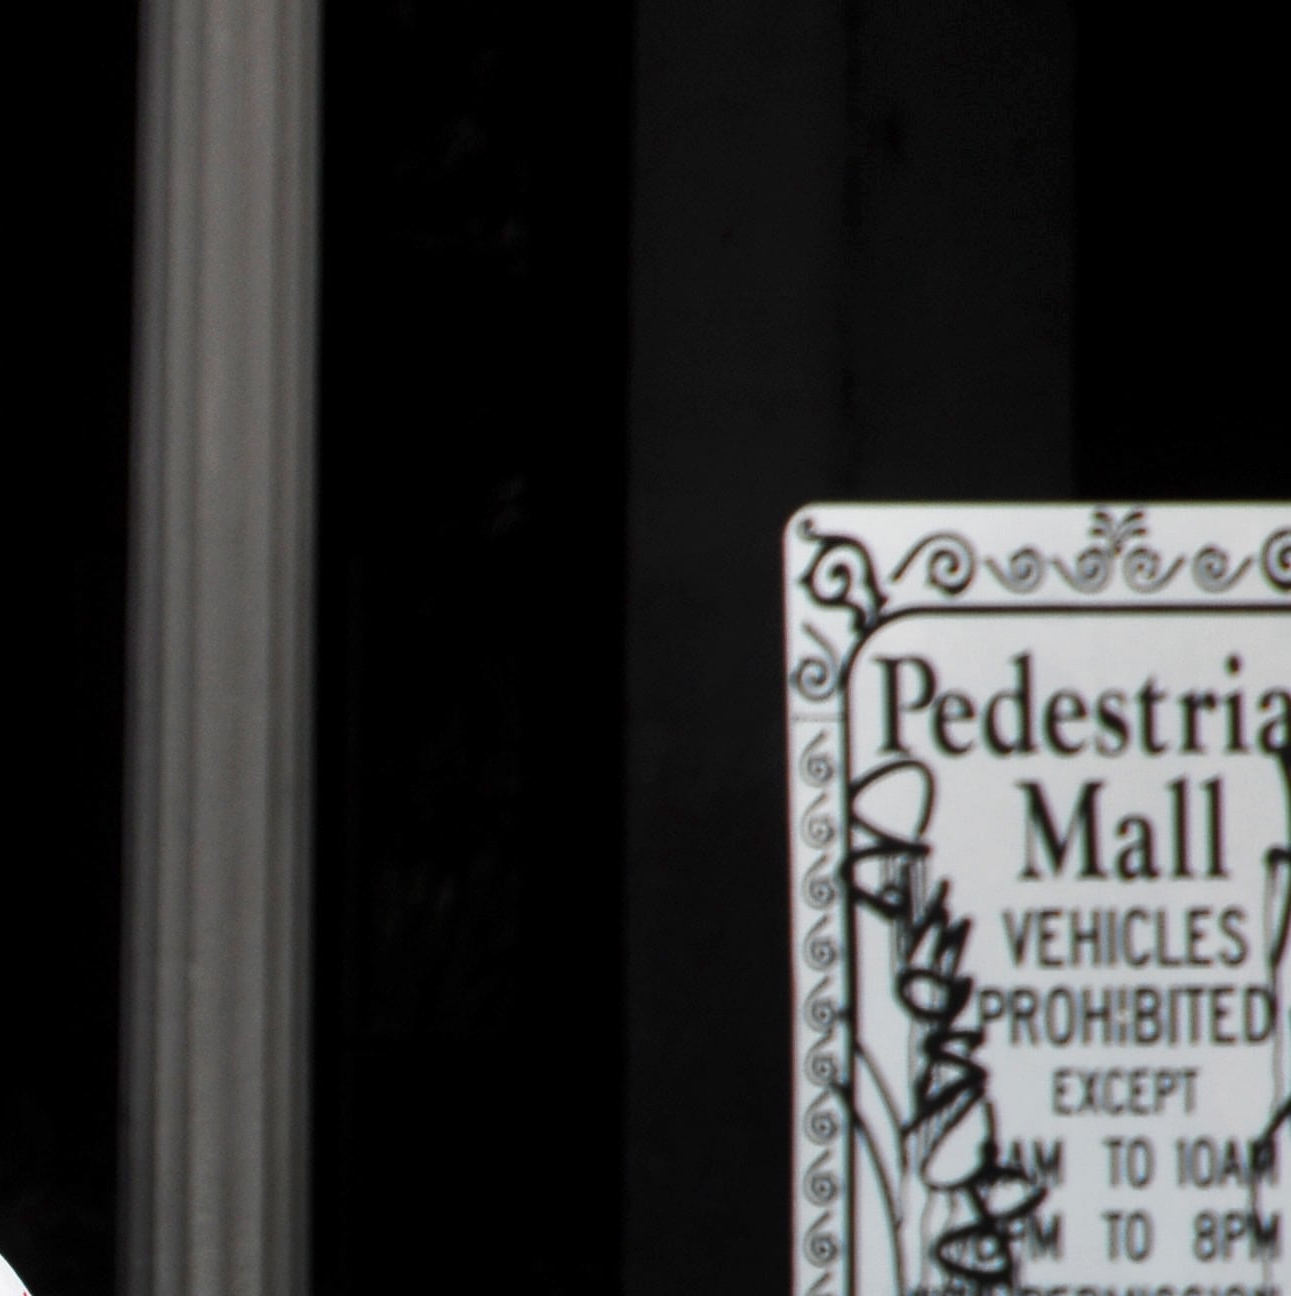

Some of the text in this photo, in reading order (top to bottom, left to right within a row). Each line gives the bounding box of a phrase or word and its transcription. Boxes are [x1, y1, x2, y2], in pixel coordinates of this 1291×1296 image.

[1016, 775, 1230, 882] Mall
[1001, 907, 1249, 969] VEHICLES
[979, 984, 1273, 1047] PROHIBITED
[1052, 1068, 1200, 1116] EXCEPT
[1103, 1136, 1154, 1188] TO
[1177, 1136, 1280, 1188] 10AM
[1102, 1210, 1154, 1262] TO
[1194, 1210, 1282, 1262] 8PM
